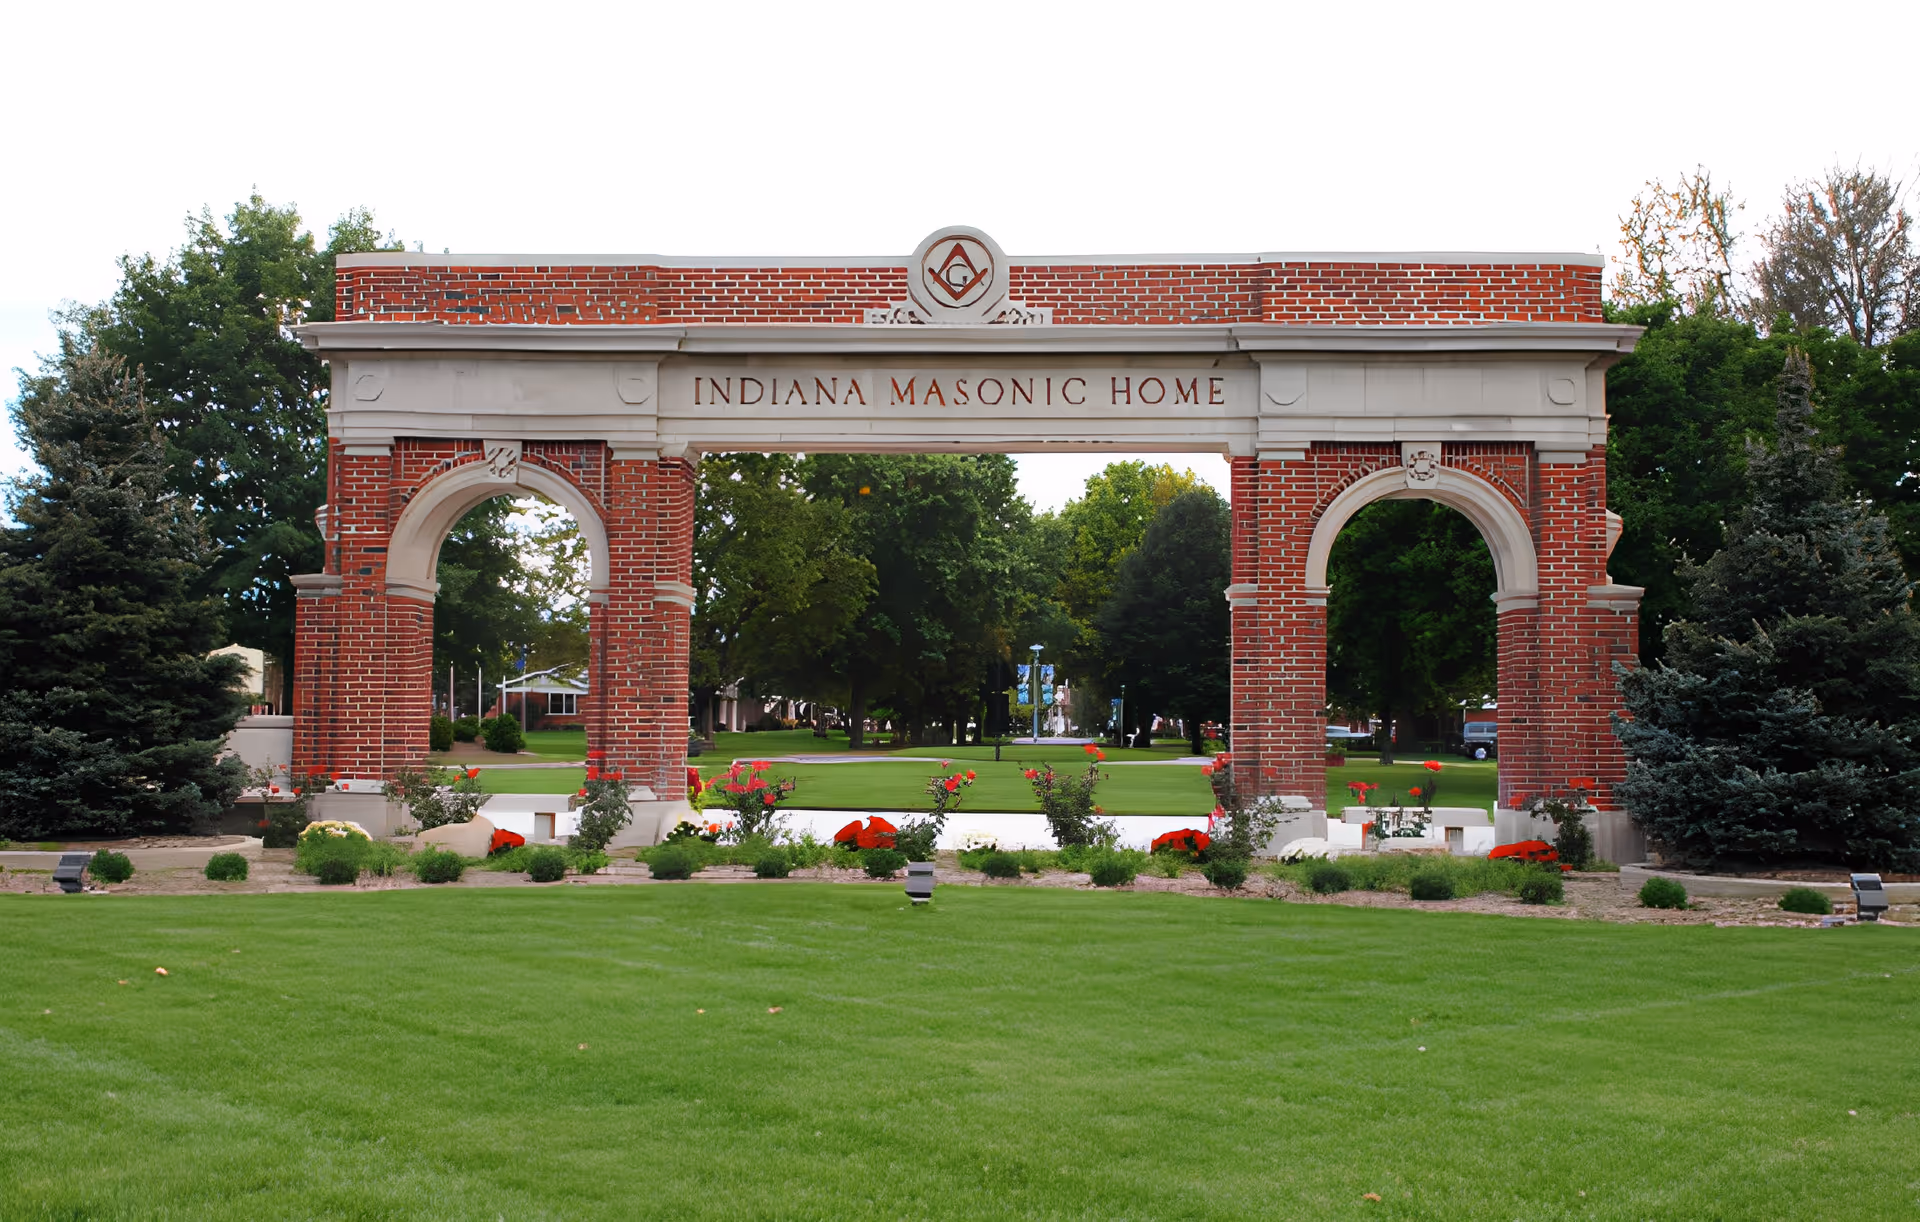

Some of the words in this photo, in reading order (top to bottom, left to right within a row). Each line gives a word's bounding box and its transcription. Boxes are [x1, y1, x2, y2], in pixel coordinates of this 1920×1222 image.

[694, 376, 867, 405] INDIANA
[890, 376, 1087, 406] MASONIC
[1110, 376, 1225, 405] HOME
